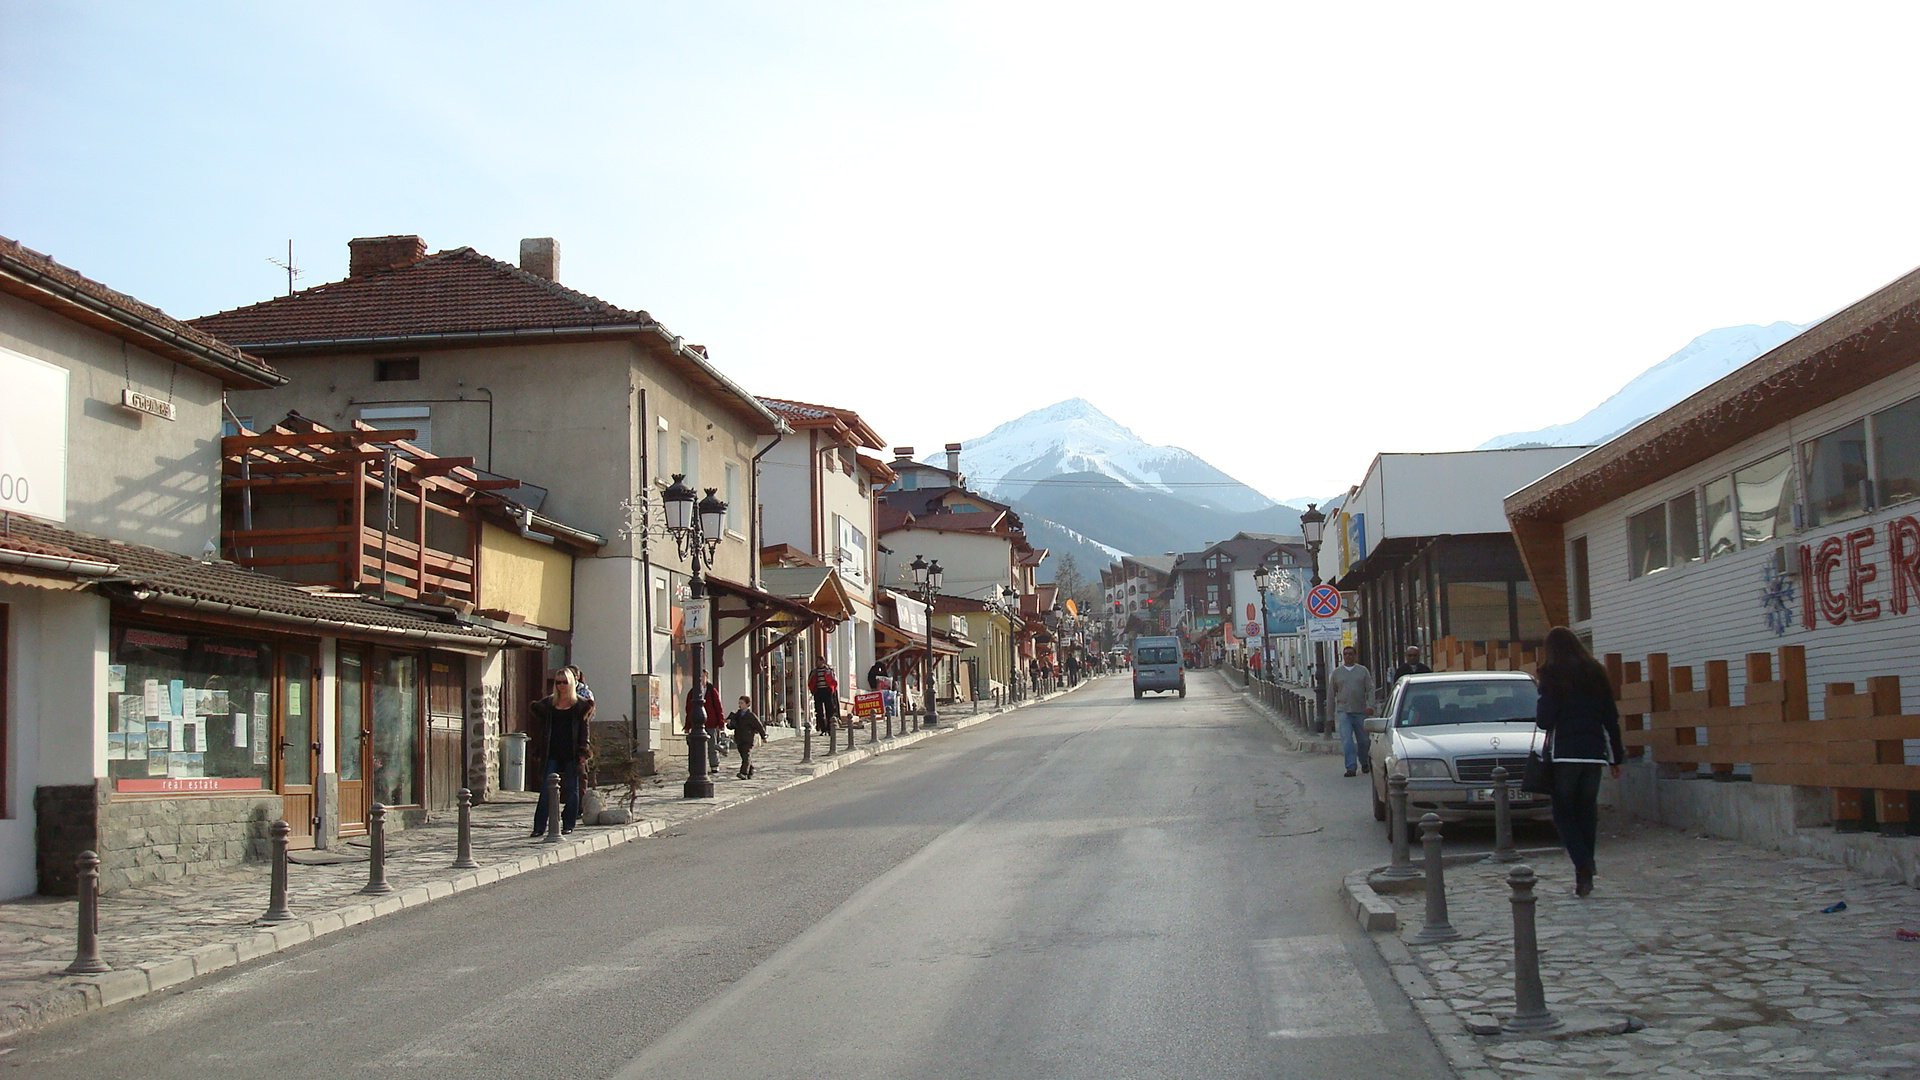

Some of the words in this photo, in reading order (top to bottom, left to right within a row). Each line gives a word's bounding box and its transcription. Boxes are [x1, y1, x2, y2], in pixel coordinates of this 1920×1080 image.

[1800, 527, 1881, 631] ICE
[162, 780, 183, 789] real
[188, 780, 218, 789] estate
